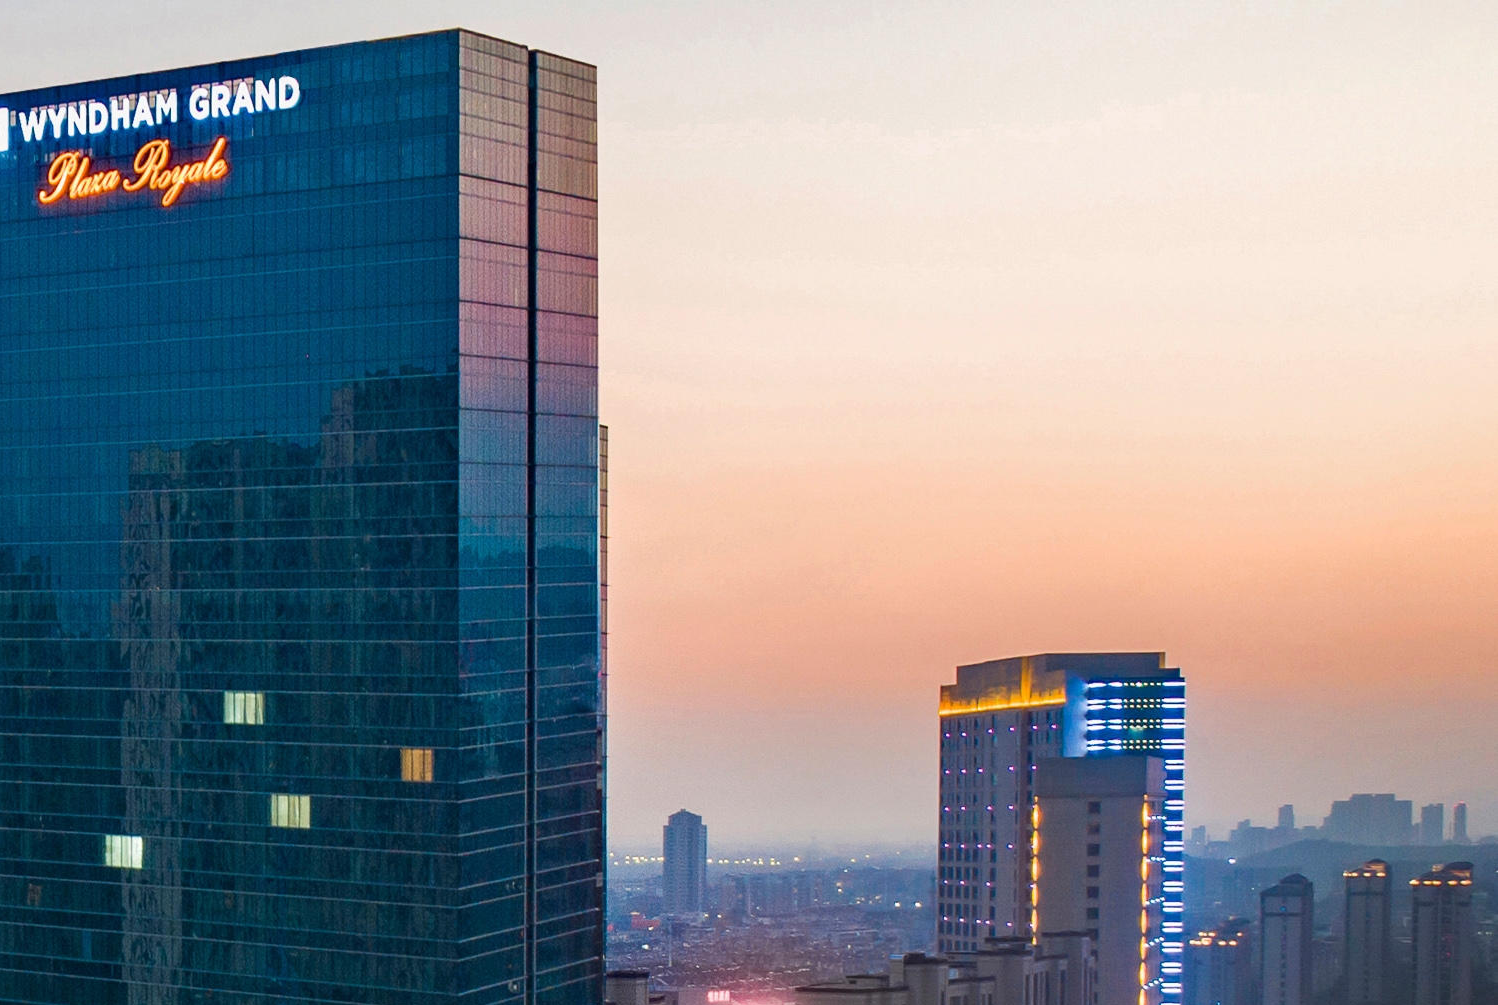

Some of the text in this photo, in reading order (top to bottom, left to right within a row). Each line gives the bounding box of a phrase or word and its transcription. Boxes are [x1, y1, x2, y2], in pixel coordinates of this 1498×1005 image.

[19, 76, 300, 142] WYNDHAM GRAND
[39, 137, 228, 206] Plaza Royale
